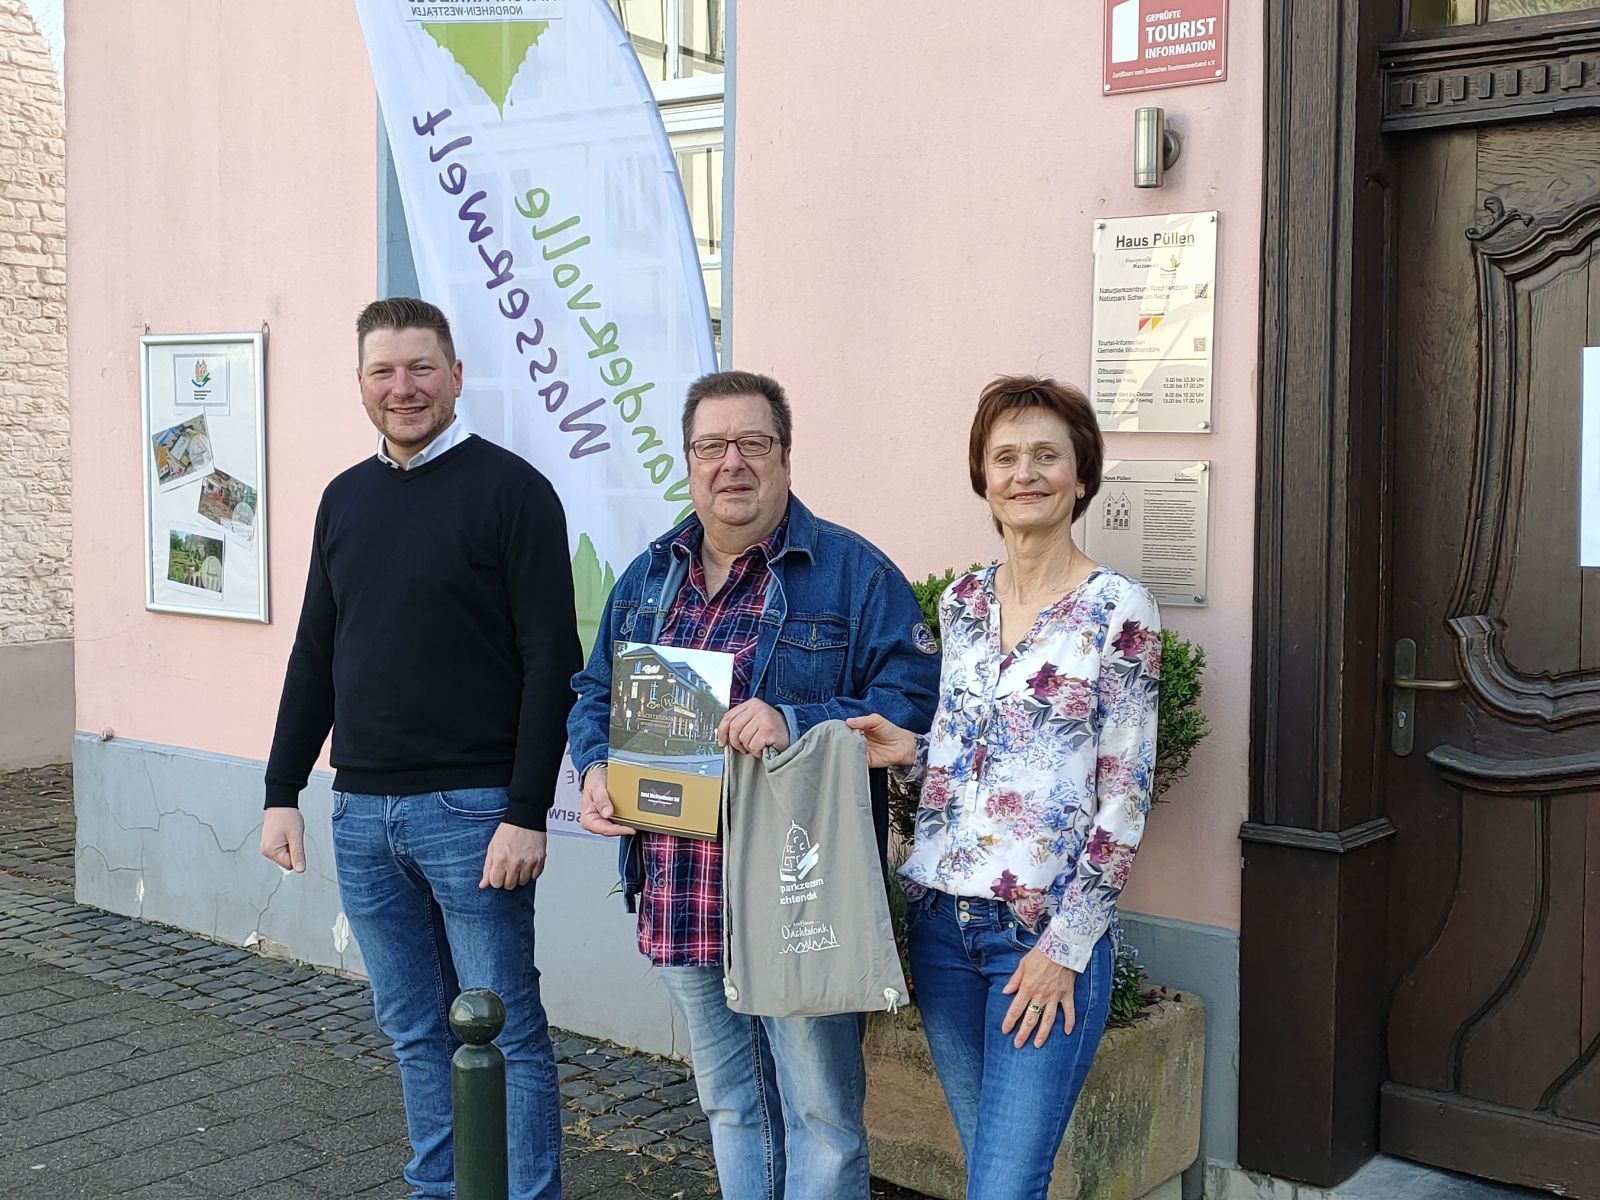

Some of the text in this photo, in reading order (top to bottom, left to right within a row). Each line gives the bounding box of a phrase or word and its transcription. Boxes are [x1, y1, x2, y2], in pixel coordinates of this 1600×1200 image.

[1146, 10, 1182, 22] GEPRÜFTE
[1146, 18, 1216, 44] TOURIST
[1146, 40, 1216, 59] INFORMATION
[1116, 232, 1194, 248] Haus Püllen
